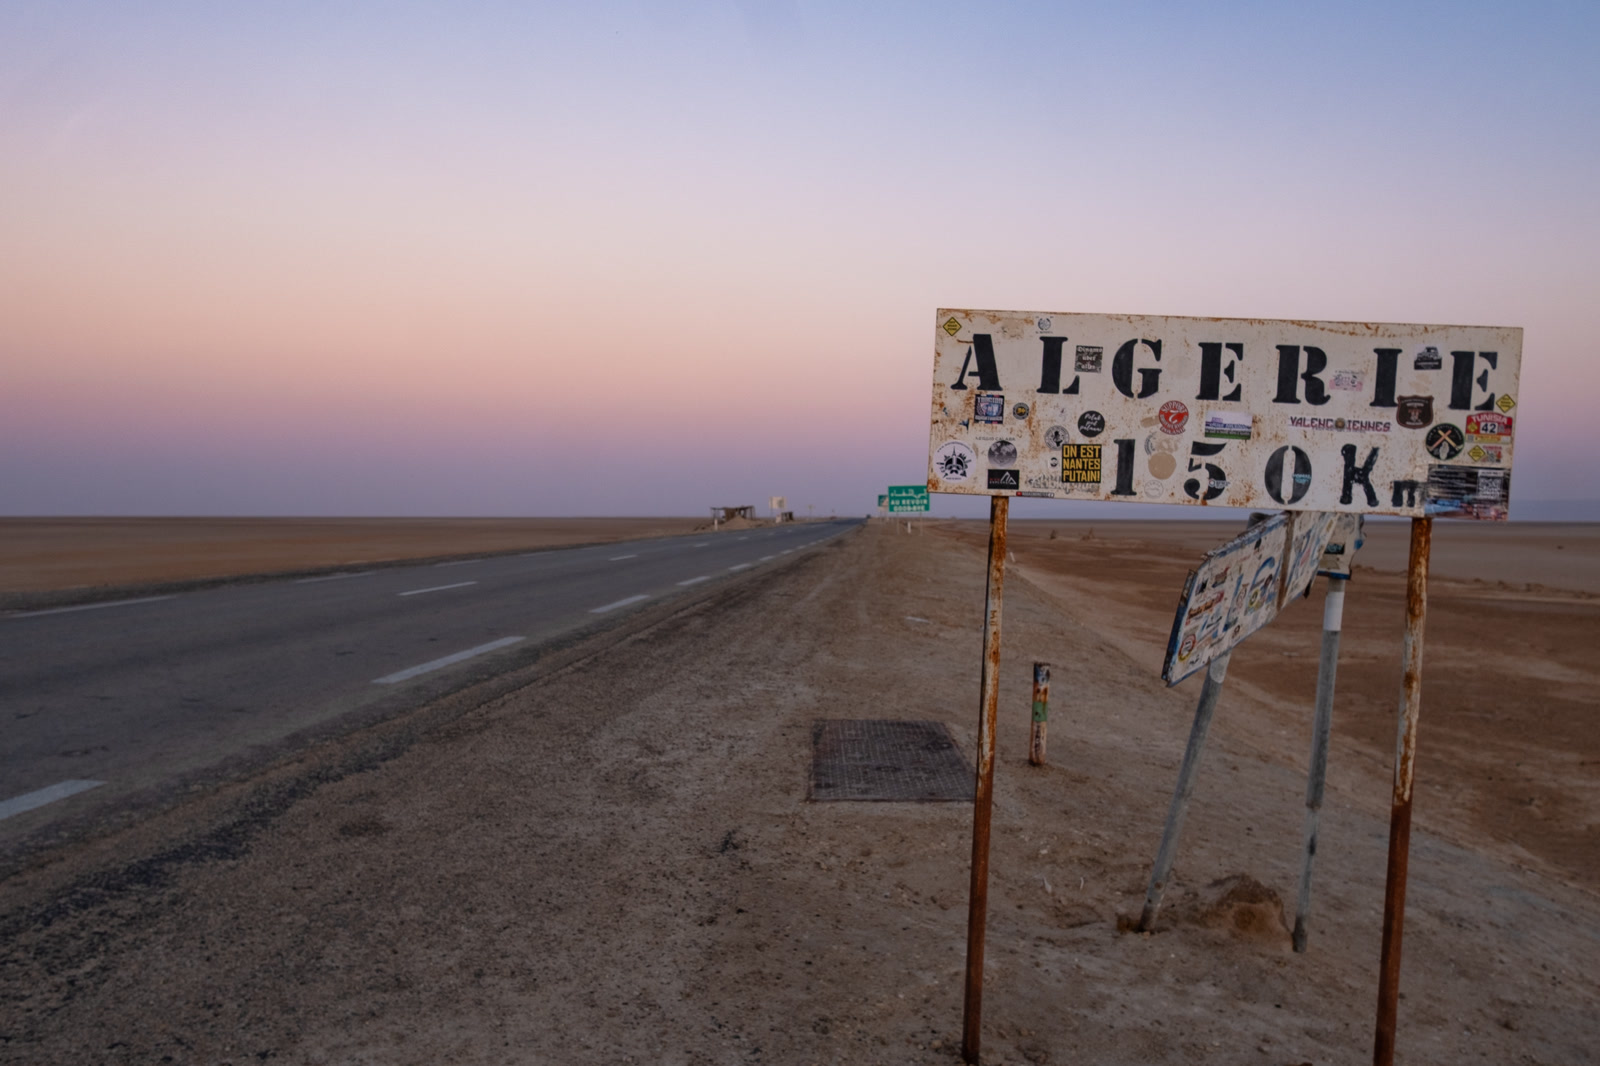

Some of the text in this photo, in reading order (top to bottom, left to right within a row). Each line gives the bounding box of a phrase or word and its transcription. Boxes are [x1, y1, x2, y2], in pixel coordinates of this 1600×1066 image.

[950, 333, 1498, 411] ALGERIE
[1160, 401, 1188, 413] SUPPORT
[1471, 413, 1508, 425] TUNISIA
[1481, 422, 1497, 434] 42
[1063, 445, 1101, 458] ON EST
[1063, 458, 1101, 470] NANTES
[1063, 470, 1101, 482] PUTAIN!
[1111, 438, 1312, 505] 150
